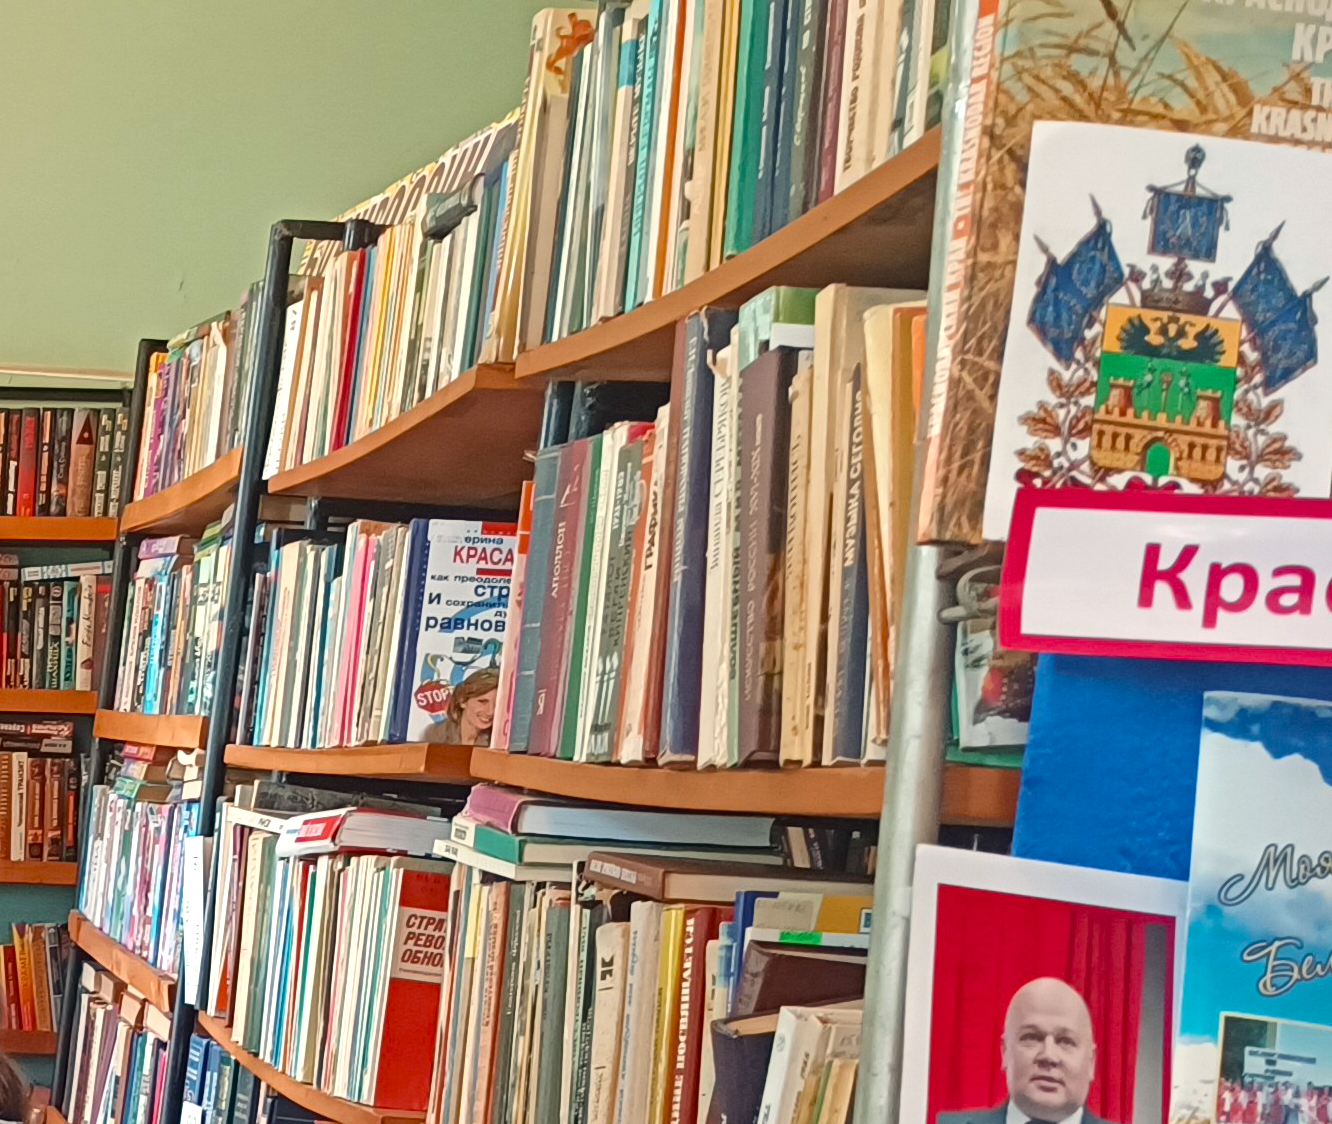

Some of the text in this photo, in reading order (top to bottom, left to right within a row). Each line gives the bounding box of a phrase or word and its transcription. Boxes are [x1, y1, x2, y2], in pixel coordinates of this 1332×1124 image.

[551, 520, 567, 598] АПОЛЛОН
[430, 574, 449, 582] как
[1137, 542, 1332, 629] Кра
[425, 616, 506, 632] равнов
[405, 914, 447, 931] СТРА
[403, 932, 445, 949] РЕВО
[401, 949, 444, 967] ОБНО
[677, 917, 697, 1069] ПОСВЯЩАЕТСЯ
